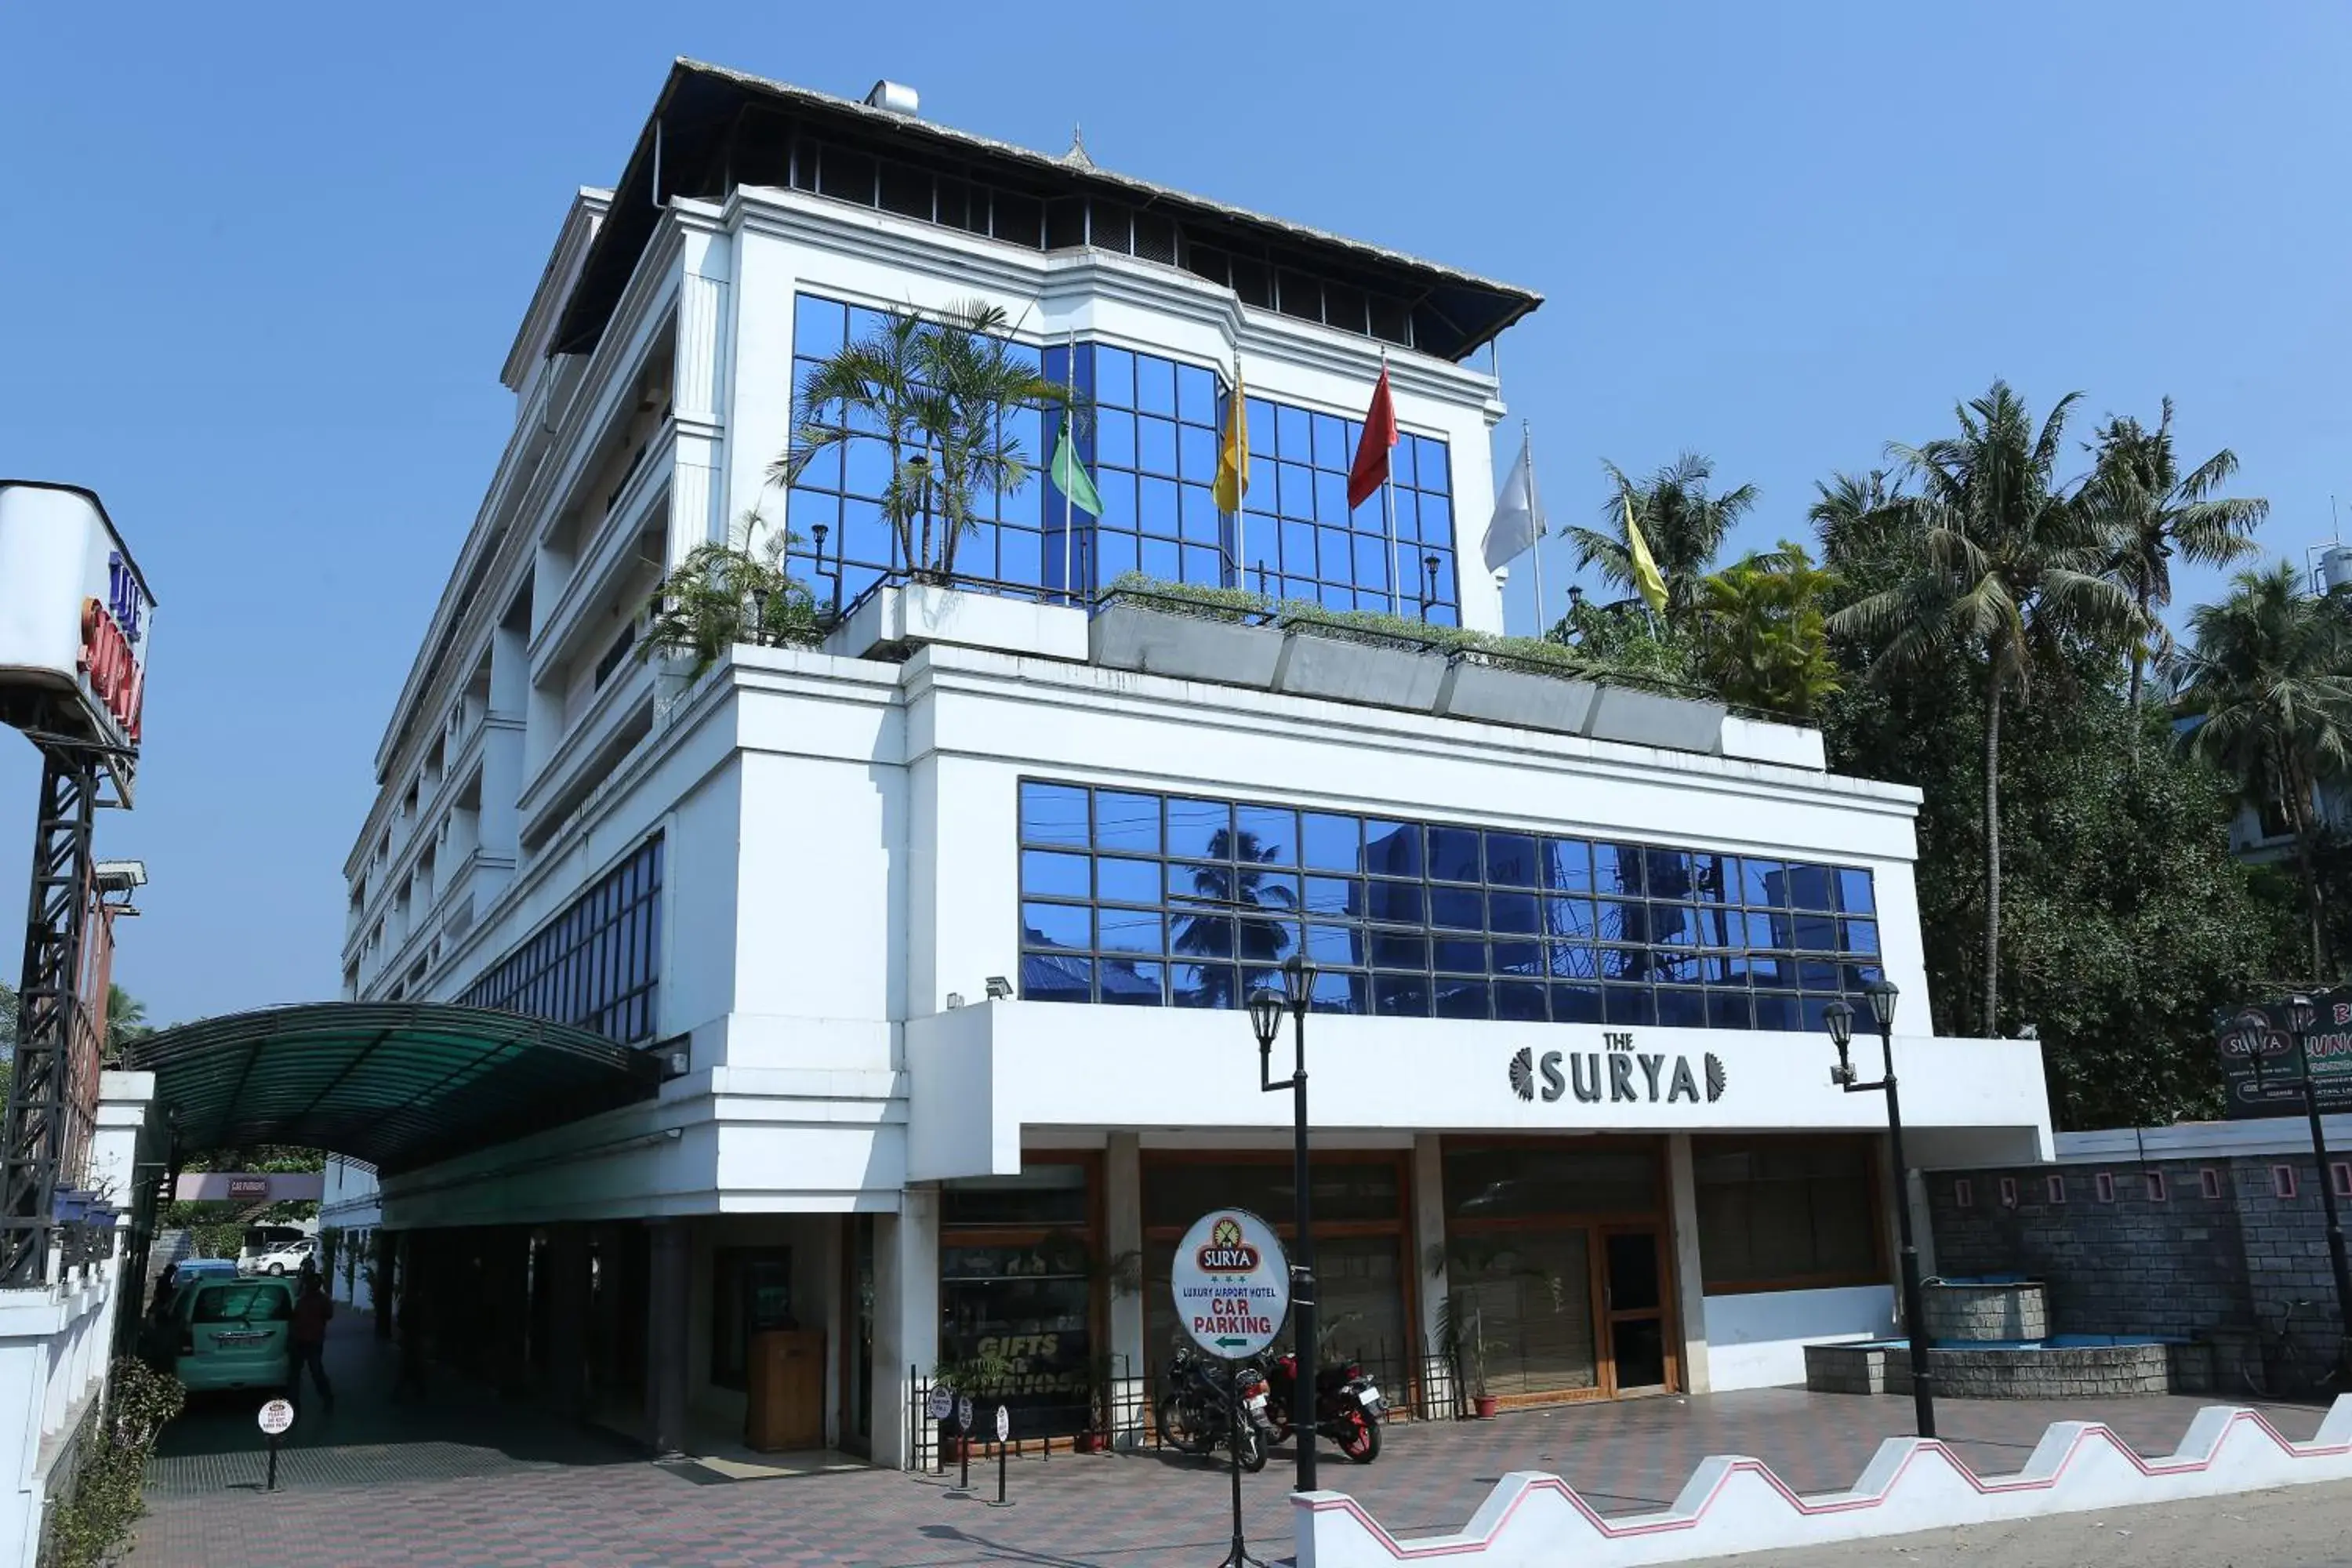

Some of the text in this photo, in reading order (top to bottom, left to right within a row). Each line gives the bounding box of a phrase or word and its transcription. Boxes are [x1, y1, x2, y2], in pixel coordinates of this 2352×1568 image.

[1603, 1032, 1635, 1051] THE
[2230, 1034, 2283, 1053] SUYA
[1540, 1051, 1700, 1104] SURYA
[1204, 1250, 1250, 1267] SURYA
[1183, 1287, 1276, 1298] LUXURY AIRPORT HOTEL
[1211, 1298, 1249, 1316] CAR
[1194, 1316, 1271, 1334] PARKING
[978, 1334, 1058, 1359] GIFTS
